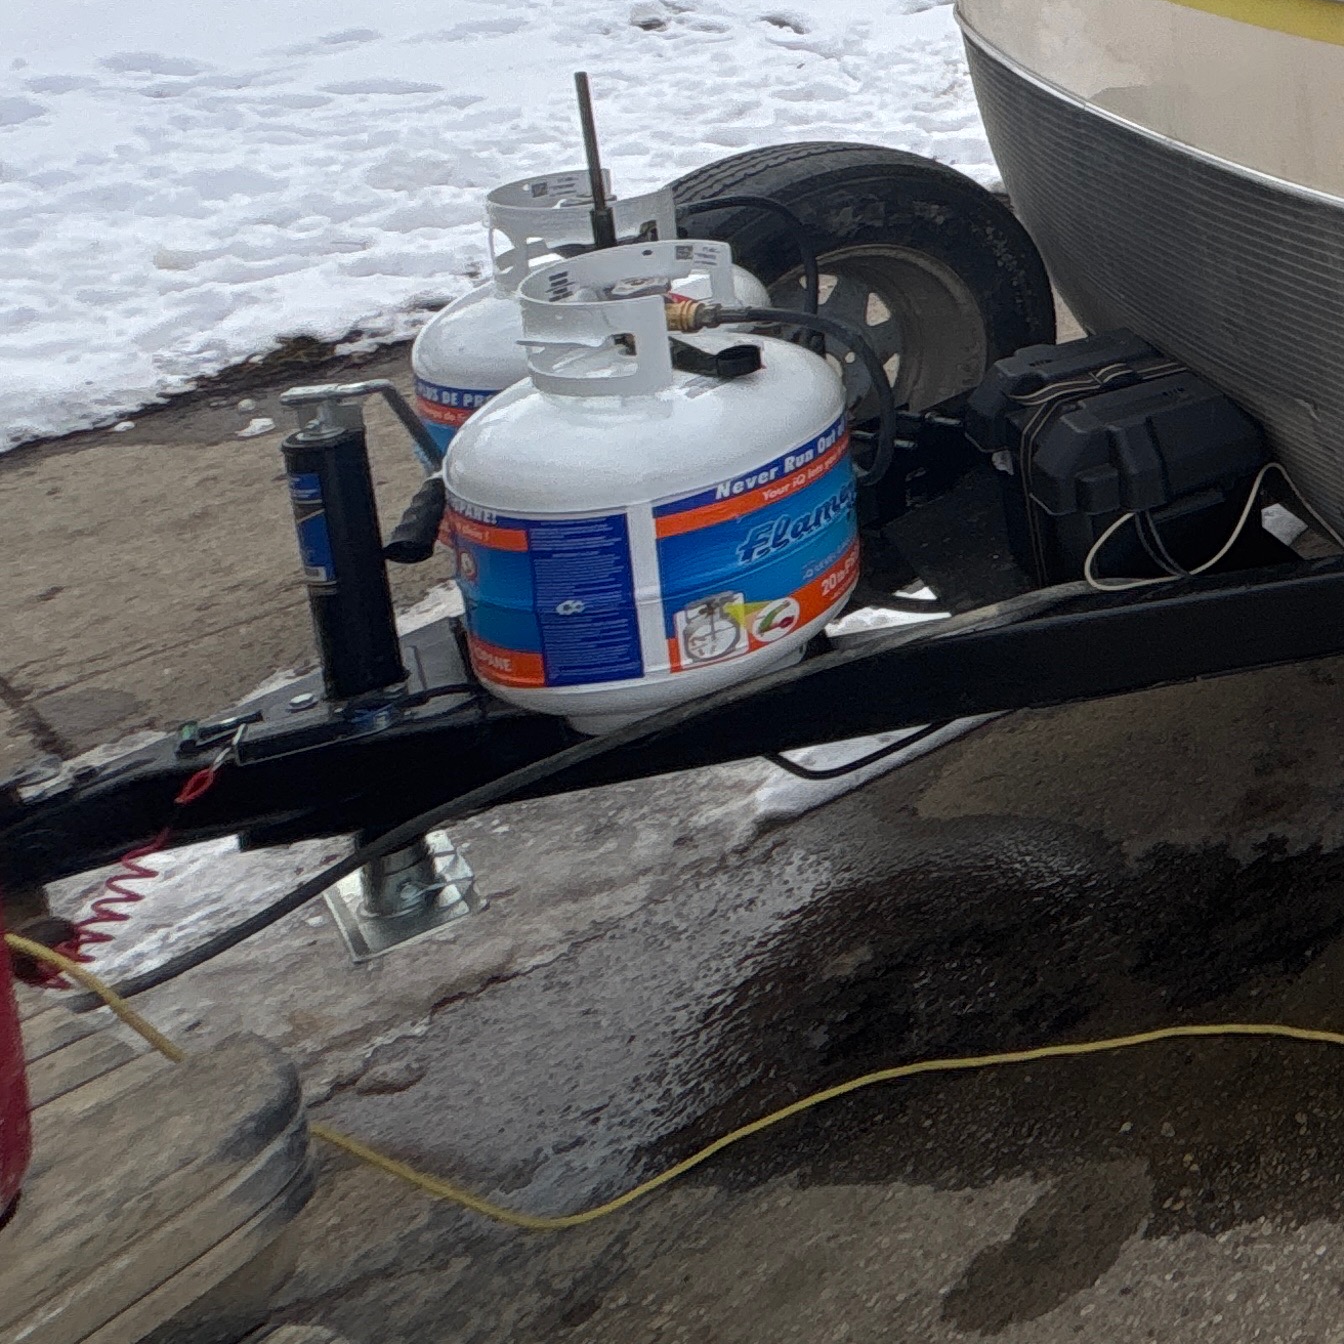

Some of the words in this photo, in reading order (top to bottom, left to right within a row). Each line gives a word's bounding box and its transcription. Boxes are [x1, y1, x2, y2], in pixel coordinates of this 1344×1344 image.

[714, 464, 779, 500] Never
[783, 448, 815, 474] Run
[762, 482, 790, 502] Your
